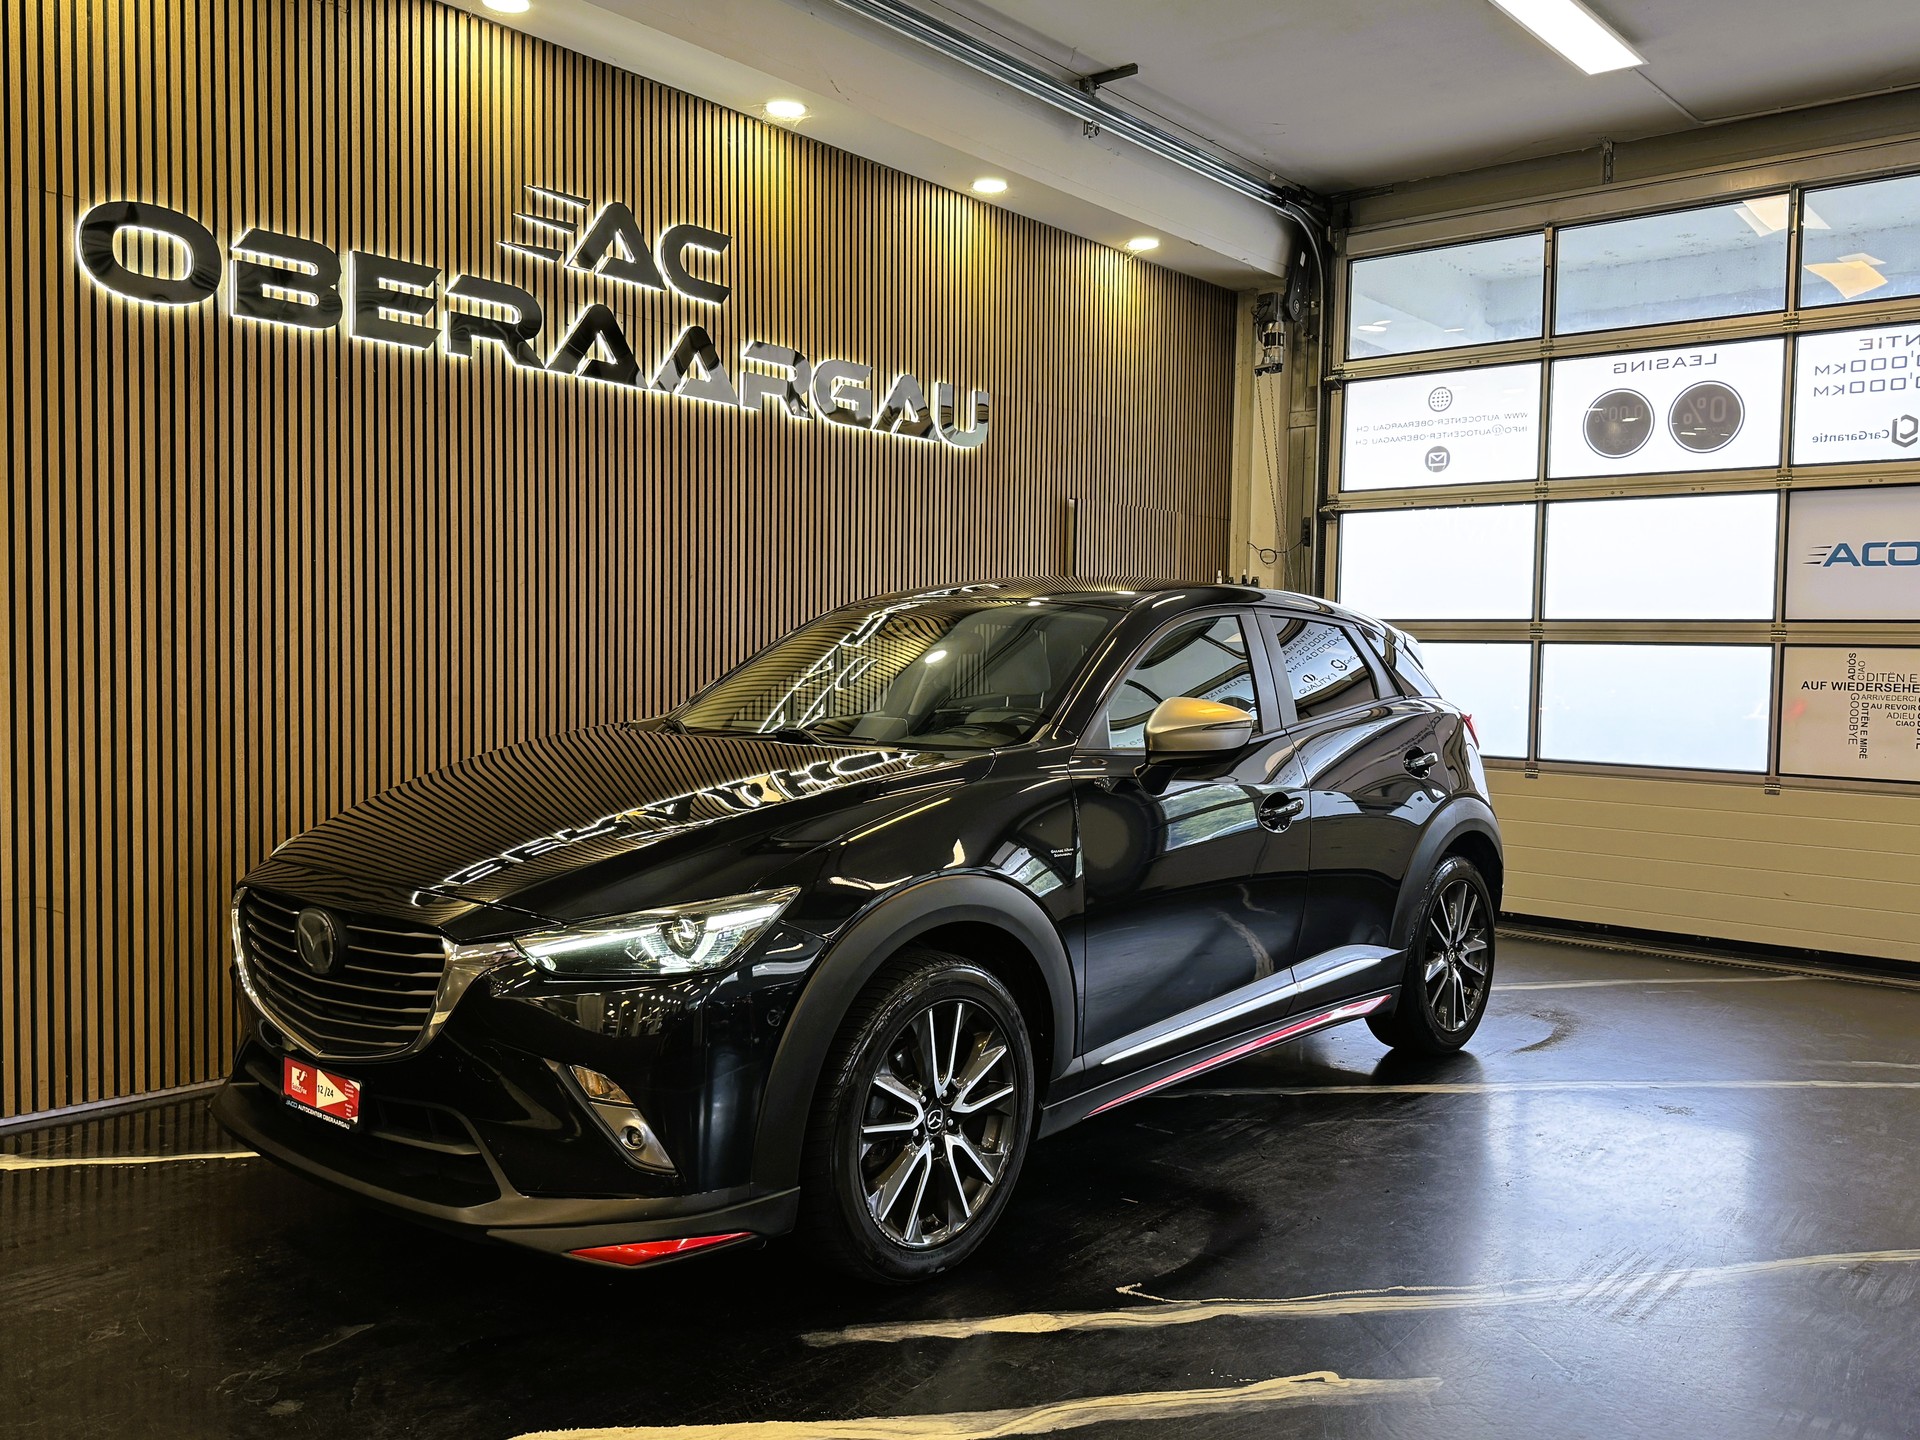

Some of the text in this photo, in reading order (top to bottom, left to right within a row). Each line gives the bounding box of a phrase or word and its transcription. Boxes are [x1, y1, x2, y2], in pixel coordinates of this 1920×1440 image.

[77, 199, 989, 450] OBERAARGAU
[1857, 660, 1866, 681] CIAO
[1909, 673, 1918, 683] E
[1801, 681, 1828, 691] AUF
[1861, 693, 1917, 702] ARRIVEDERCI
[1884, 703, 1917, 711] REVOIR
[1848, 692, 1860, 745] GOODBYE
[1886, 712, 1915, 720] ADIEU
